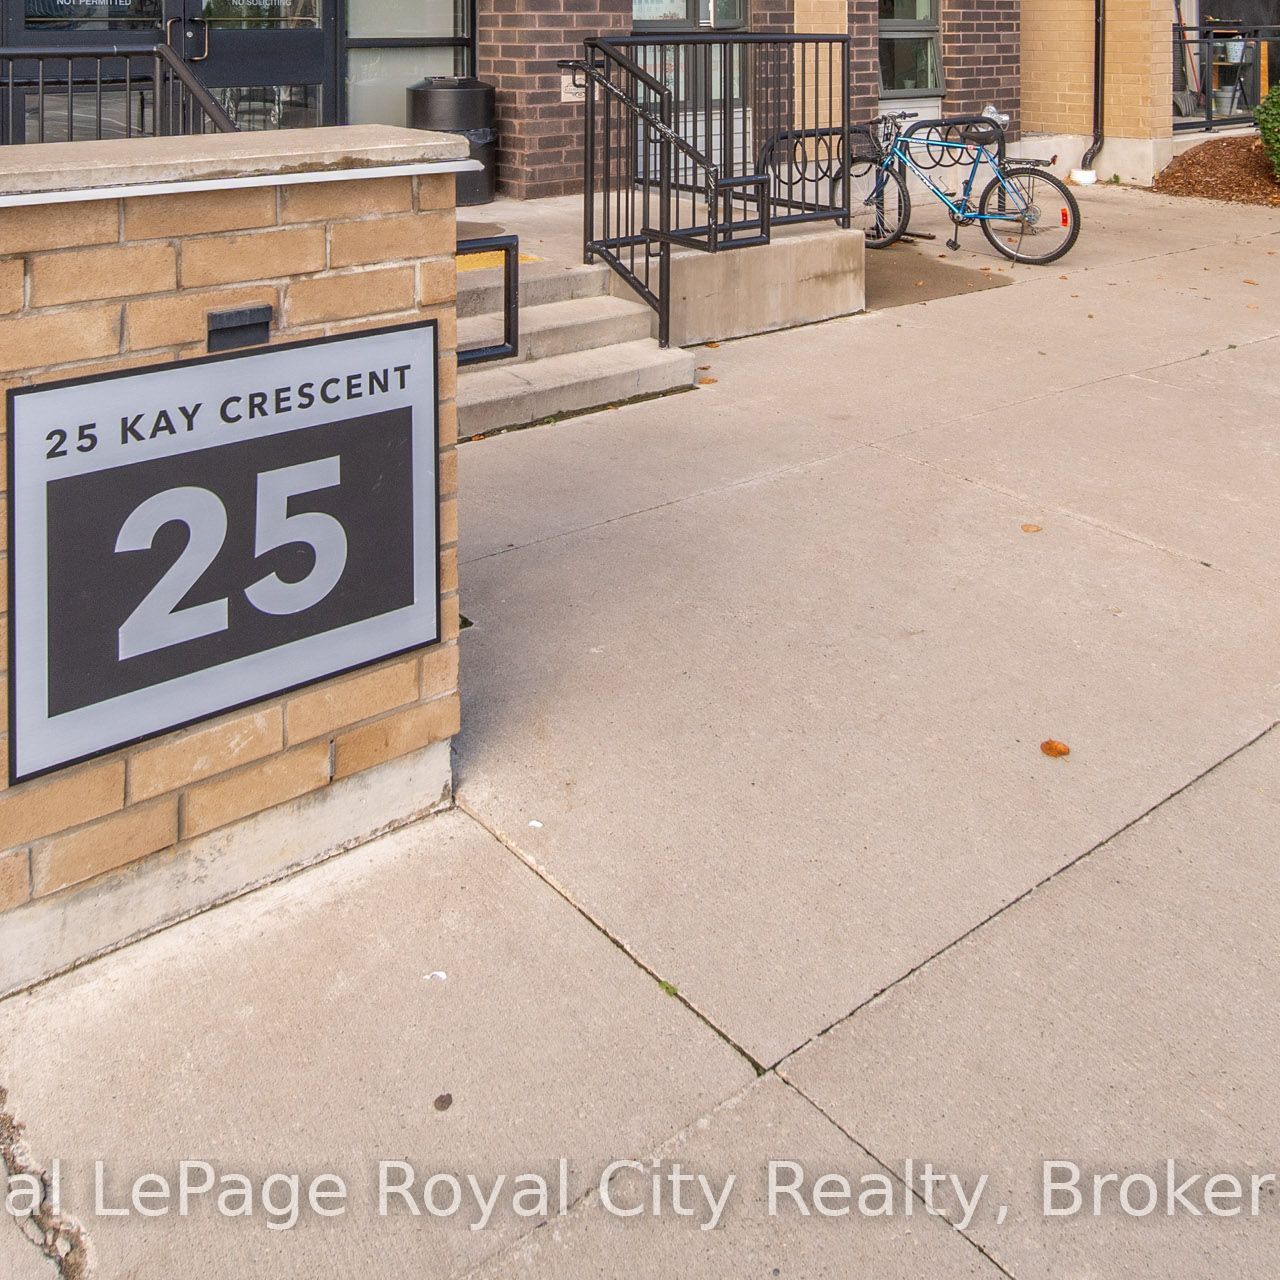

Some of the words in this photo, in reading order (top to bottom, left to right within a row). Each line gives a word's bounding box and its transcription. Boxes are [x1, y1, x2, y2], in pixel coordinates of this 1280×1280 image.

[45, 422, 98, 460] 25
[120, 402, 203, 445] KAY
[219, 364, 413, 424] CRESCENT
[113, 454, 348, 661] 25
